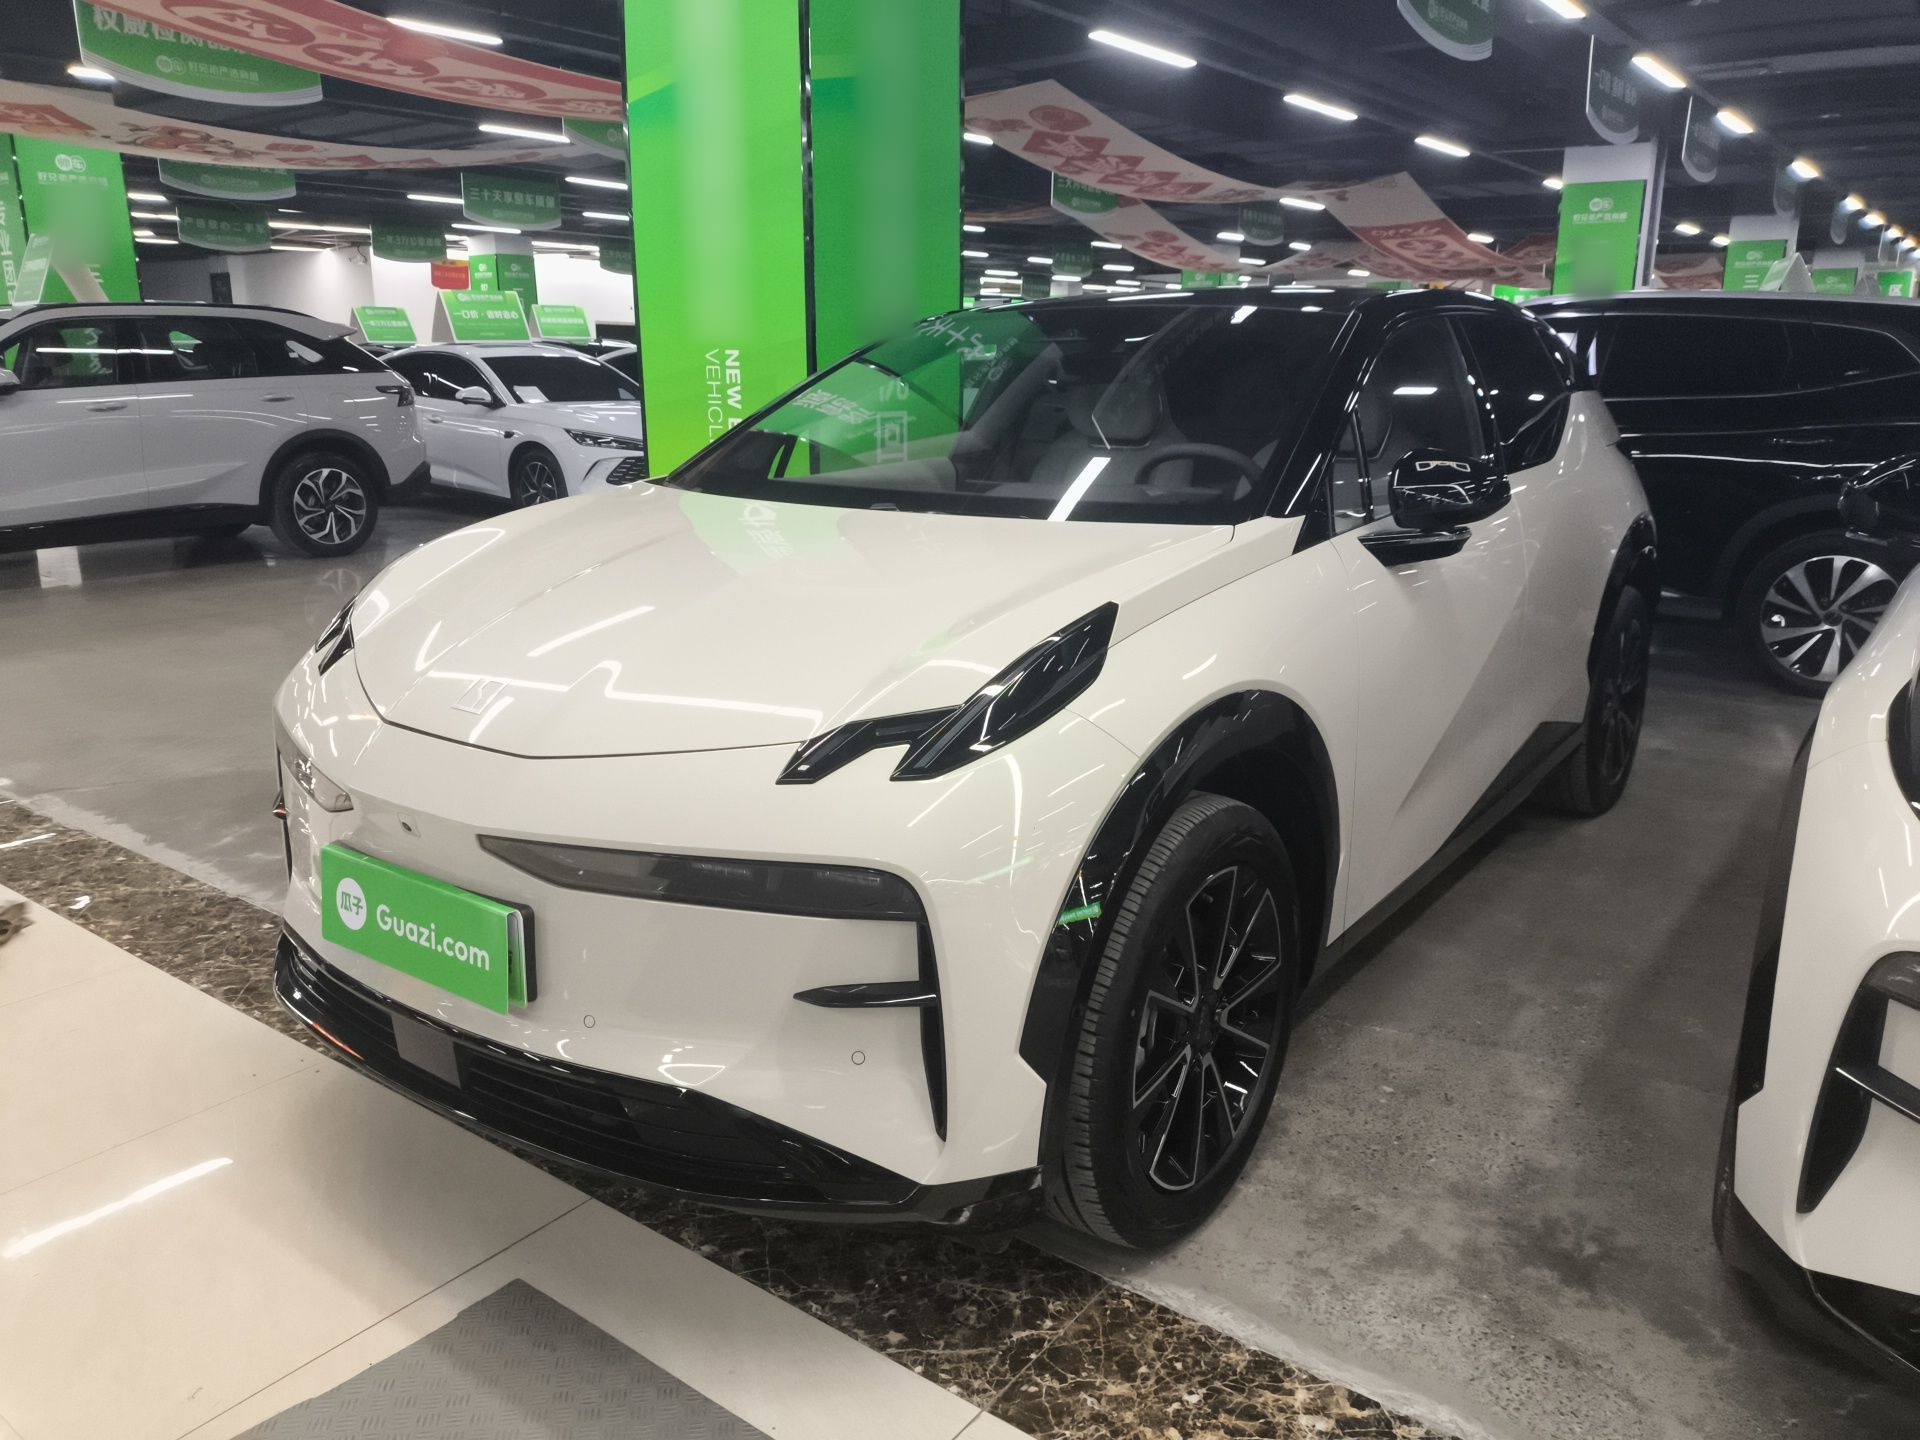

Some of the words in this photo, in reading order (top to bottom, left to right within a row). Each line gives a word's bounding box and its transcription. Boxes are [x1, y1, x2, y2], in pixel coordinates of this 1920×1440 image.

[704, 348, 723, 444] VEHICL
[724, 349, 742, 409] NEW
[340, 890, 364, 917] 瓜子
[376, 904, 490, 972] Guazi.com
